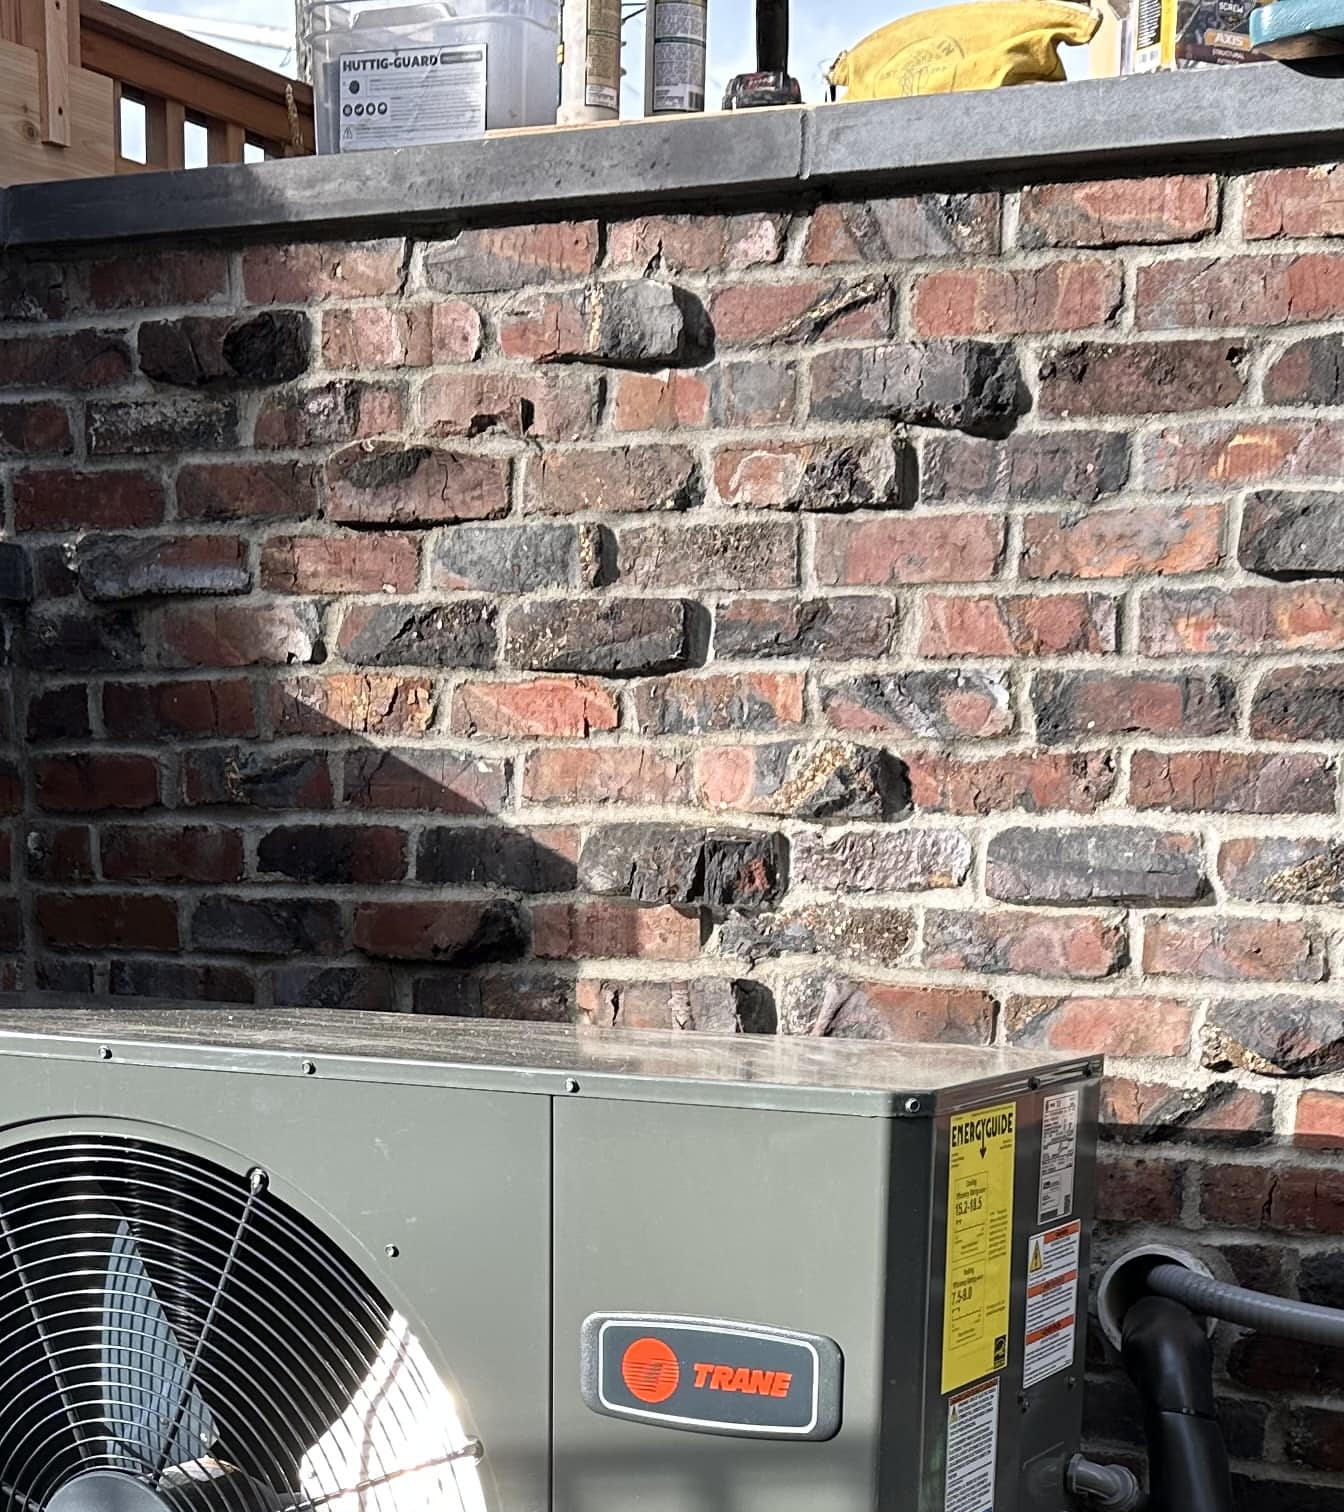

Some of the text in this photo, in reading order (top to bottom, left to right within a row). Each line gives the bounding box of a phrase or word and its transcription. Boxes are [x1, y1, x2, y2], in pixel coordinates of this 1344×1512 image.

[1214, 34, 1244, 46] AXIS
[342, 55, 438, 72] HUTTIG-GUARD
[951, 1112, 1013, 1148] ENERGYGUIDE
[693, 1363, 793, 1398] TRANE
